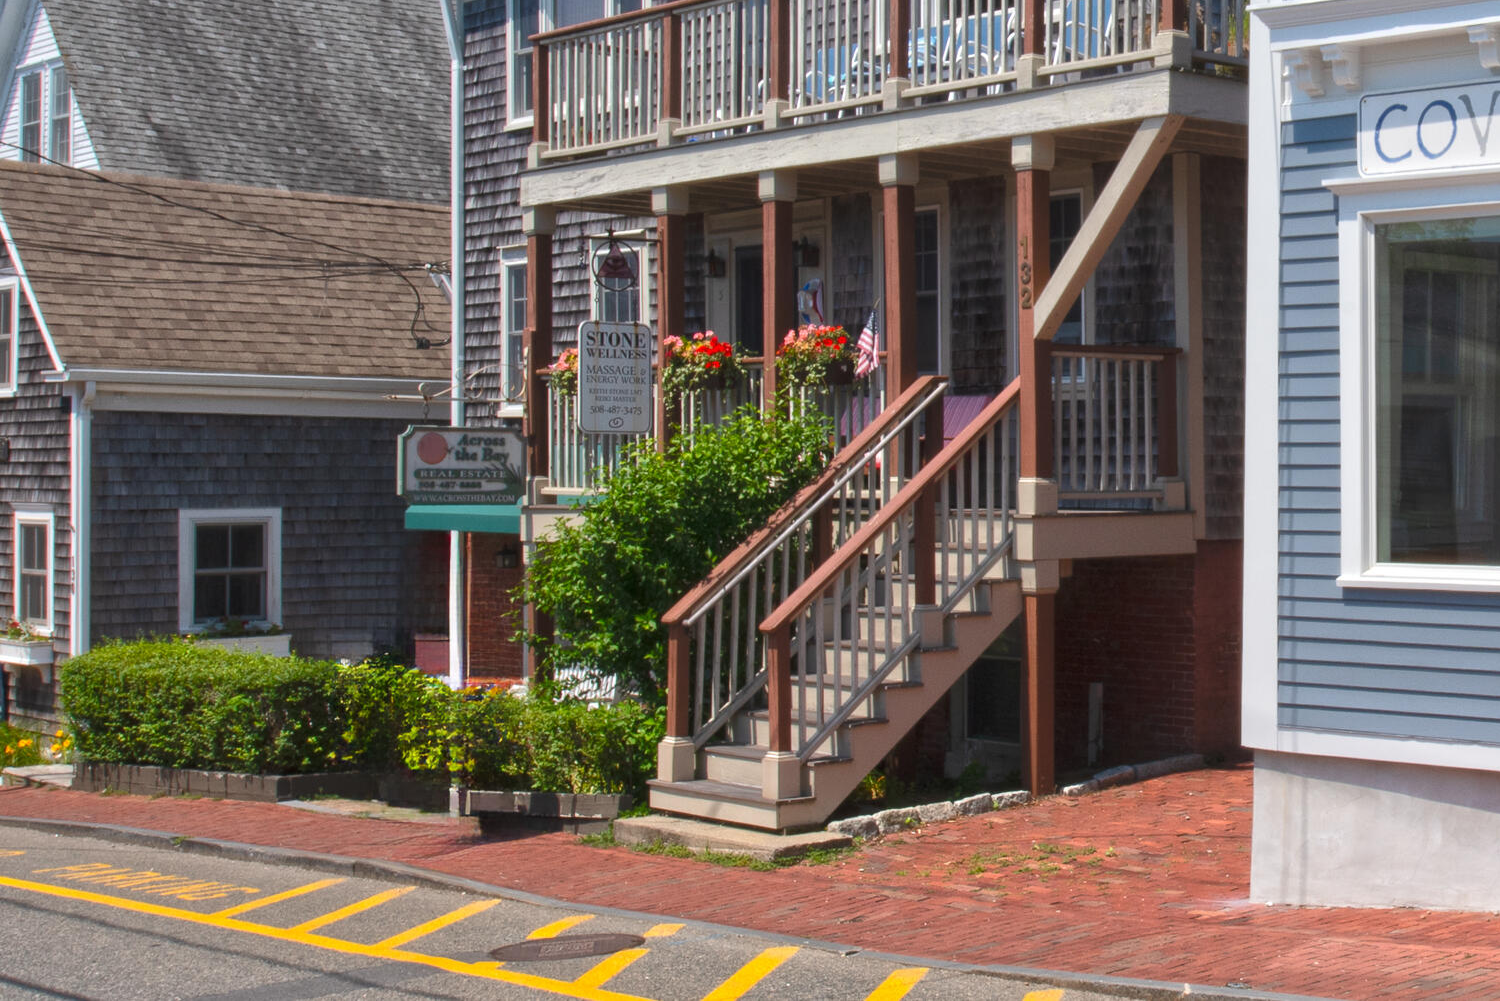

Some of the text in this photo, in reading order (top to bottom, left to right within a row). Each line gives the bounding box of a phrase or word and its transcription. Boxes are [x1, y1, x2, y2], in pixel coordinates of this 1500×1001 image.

[1020, 236, 1032, 310] 132
[586, 331, 647, 348] STONE
[586, 348, 648, 359] WELLNESS
[586, 365, 647, 376] MASSAGE &
[586, 375, 647, 386] ENERGY WORK
[589, 405, 643, 415] 508-487-3475
[457, 434, 506, 447] Across
[455, 448, 510, 463] the Bay
[420, 469, 507, 478] REAL ESTATE
[32, 862, 261, 901] PARKING
